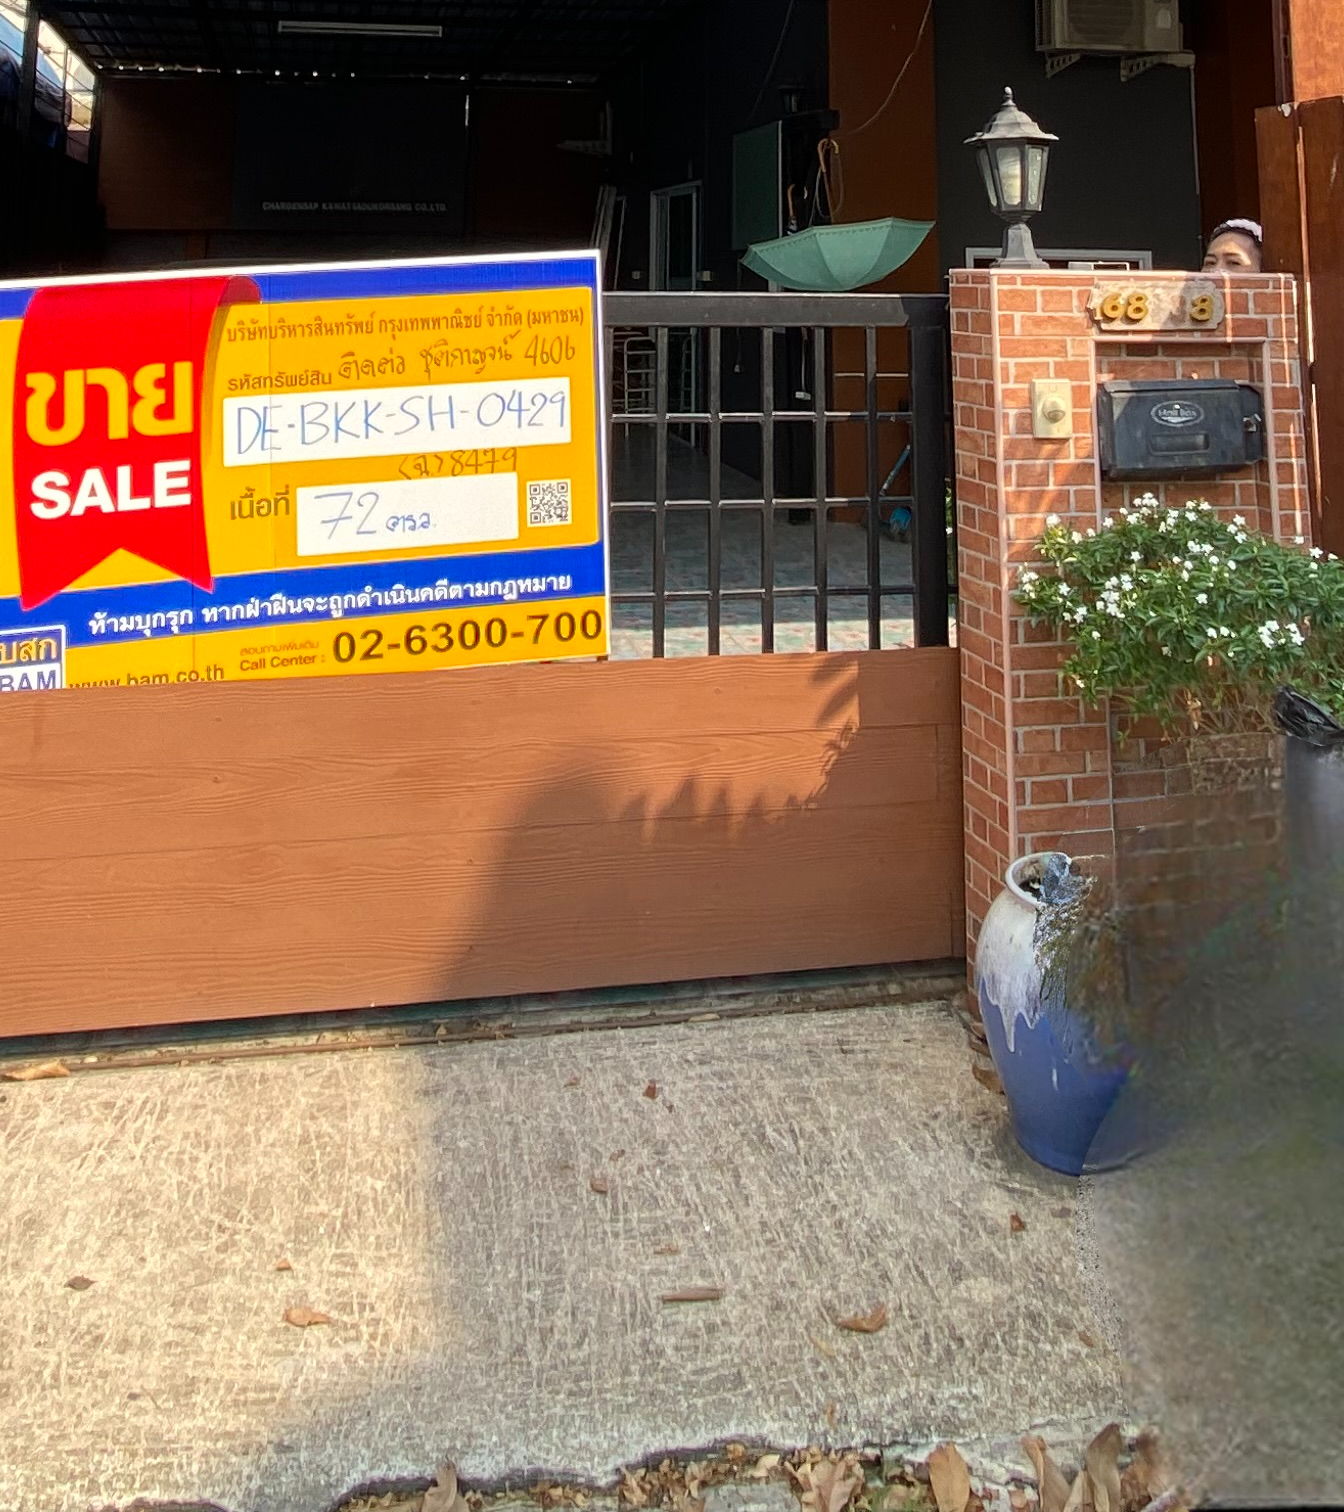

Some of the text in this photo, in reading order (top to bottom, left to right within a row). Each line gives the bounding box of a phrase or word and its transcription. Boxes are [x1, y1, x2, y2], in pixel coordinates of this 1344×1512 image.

[227, 304, 584, 343] บริษัทบริหารสินทรัพย์ กรุงเทพพาณิชย์ จำกัด (มหาชน)
[227, 369, 333, 392] รหัสทรัพย์สิน
[338, 347, 406, 381] ติดต่อ
[25, 360, 194, 447] ขาย
[29, 458, 192, 520] SALE
[230, 483, 291, 521] เนื้อที่
[313, 491, 380, 540] 72
[87, 607, 194, 638] ห้ามบุกรุก
[239, 657, 266, 672] Call
[270, 654, 318, 669] Center
[332, 608, 603, 664] 02-6300-700
